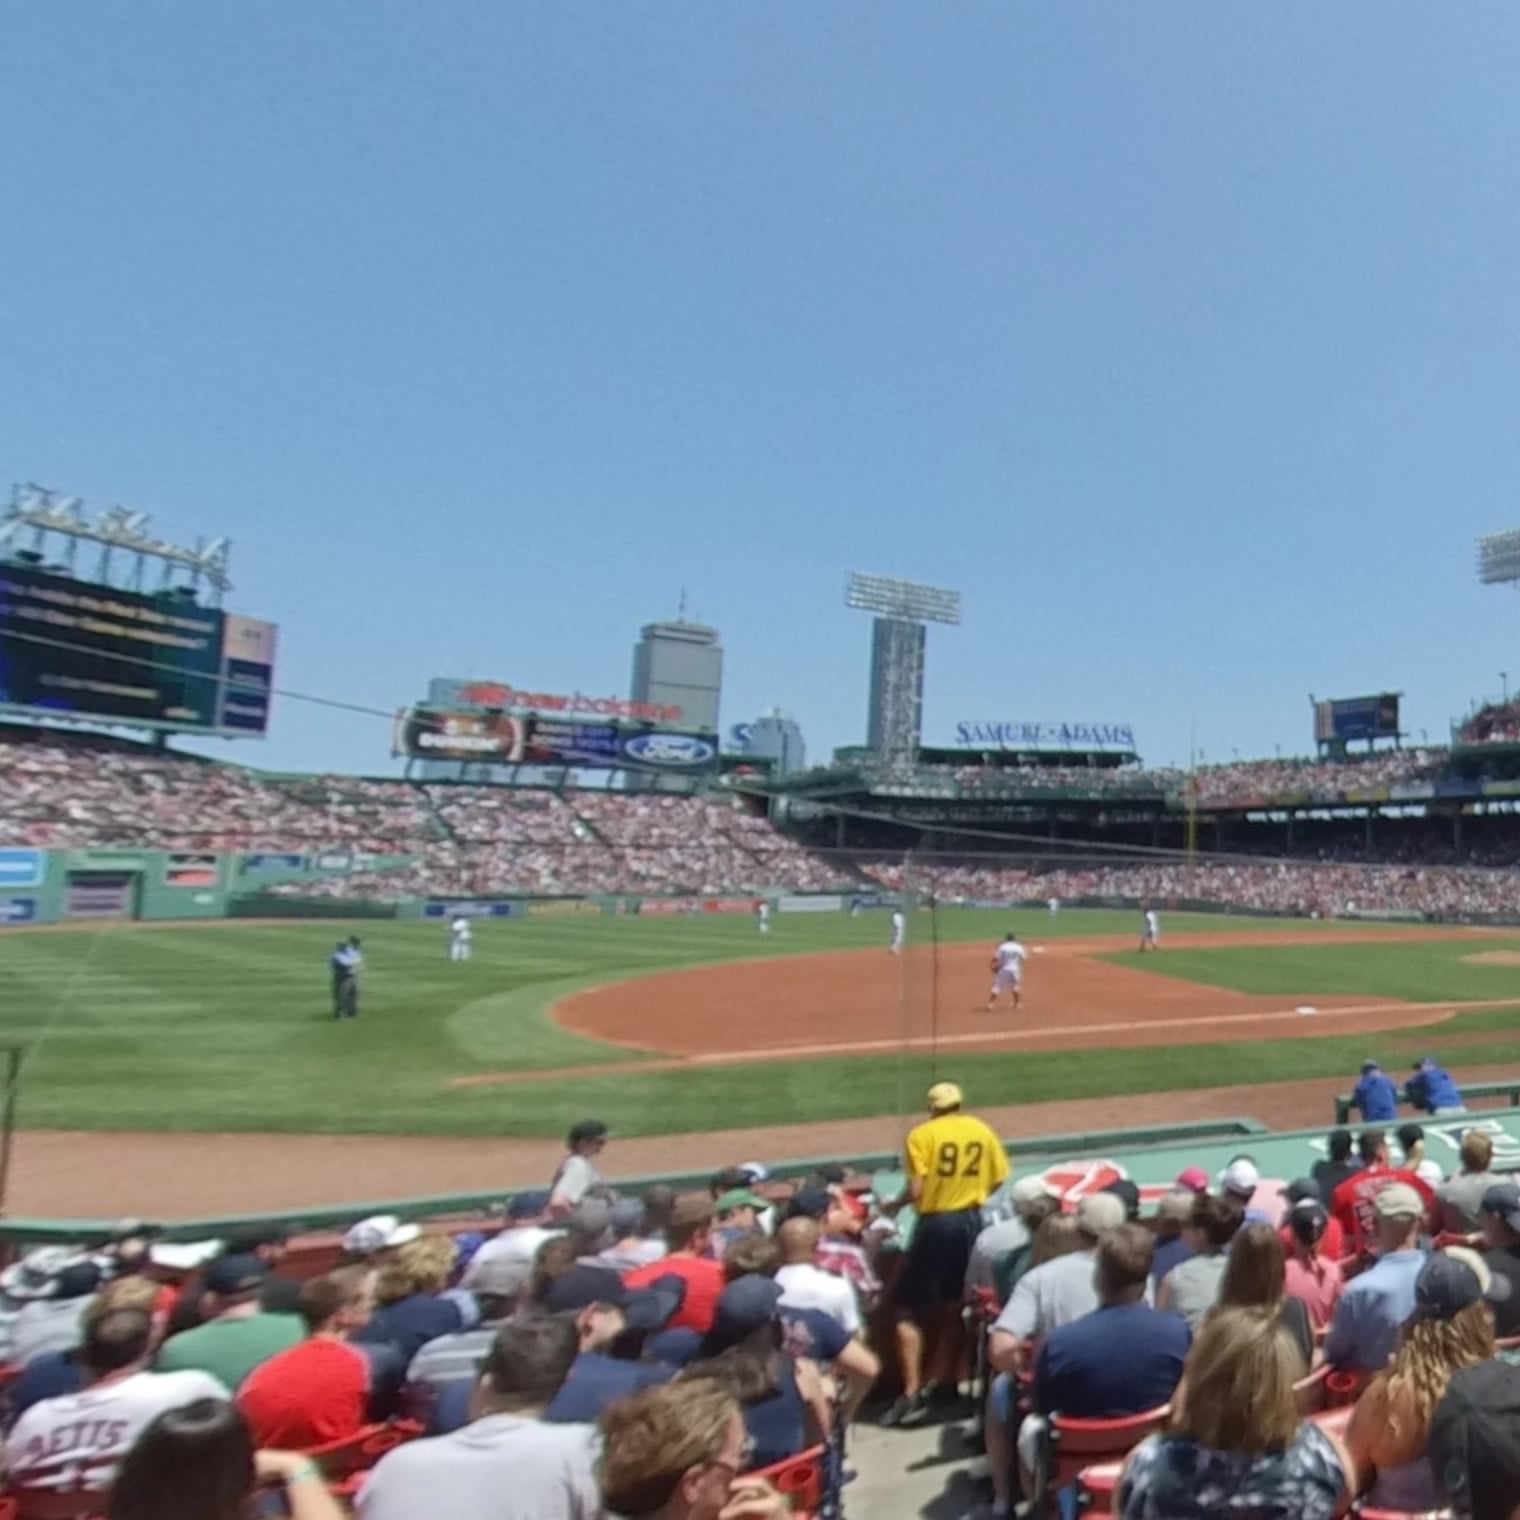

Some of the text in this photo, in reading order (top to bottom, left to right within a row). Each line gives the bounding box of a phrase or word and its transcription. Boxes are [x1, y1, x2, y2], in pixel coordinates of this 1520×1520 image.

[512, 689, 684, 722] new balance
[955, 720, 1136, 746] SAMUEL ADAMS
[641, 740, 698, 761] Ford
[937, 1140, 984, 1178] 92
[23, 1418, 131, 1465] BETTS
